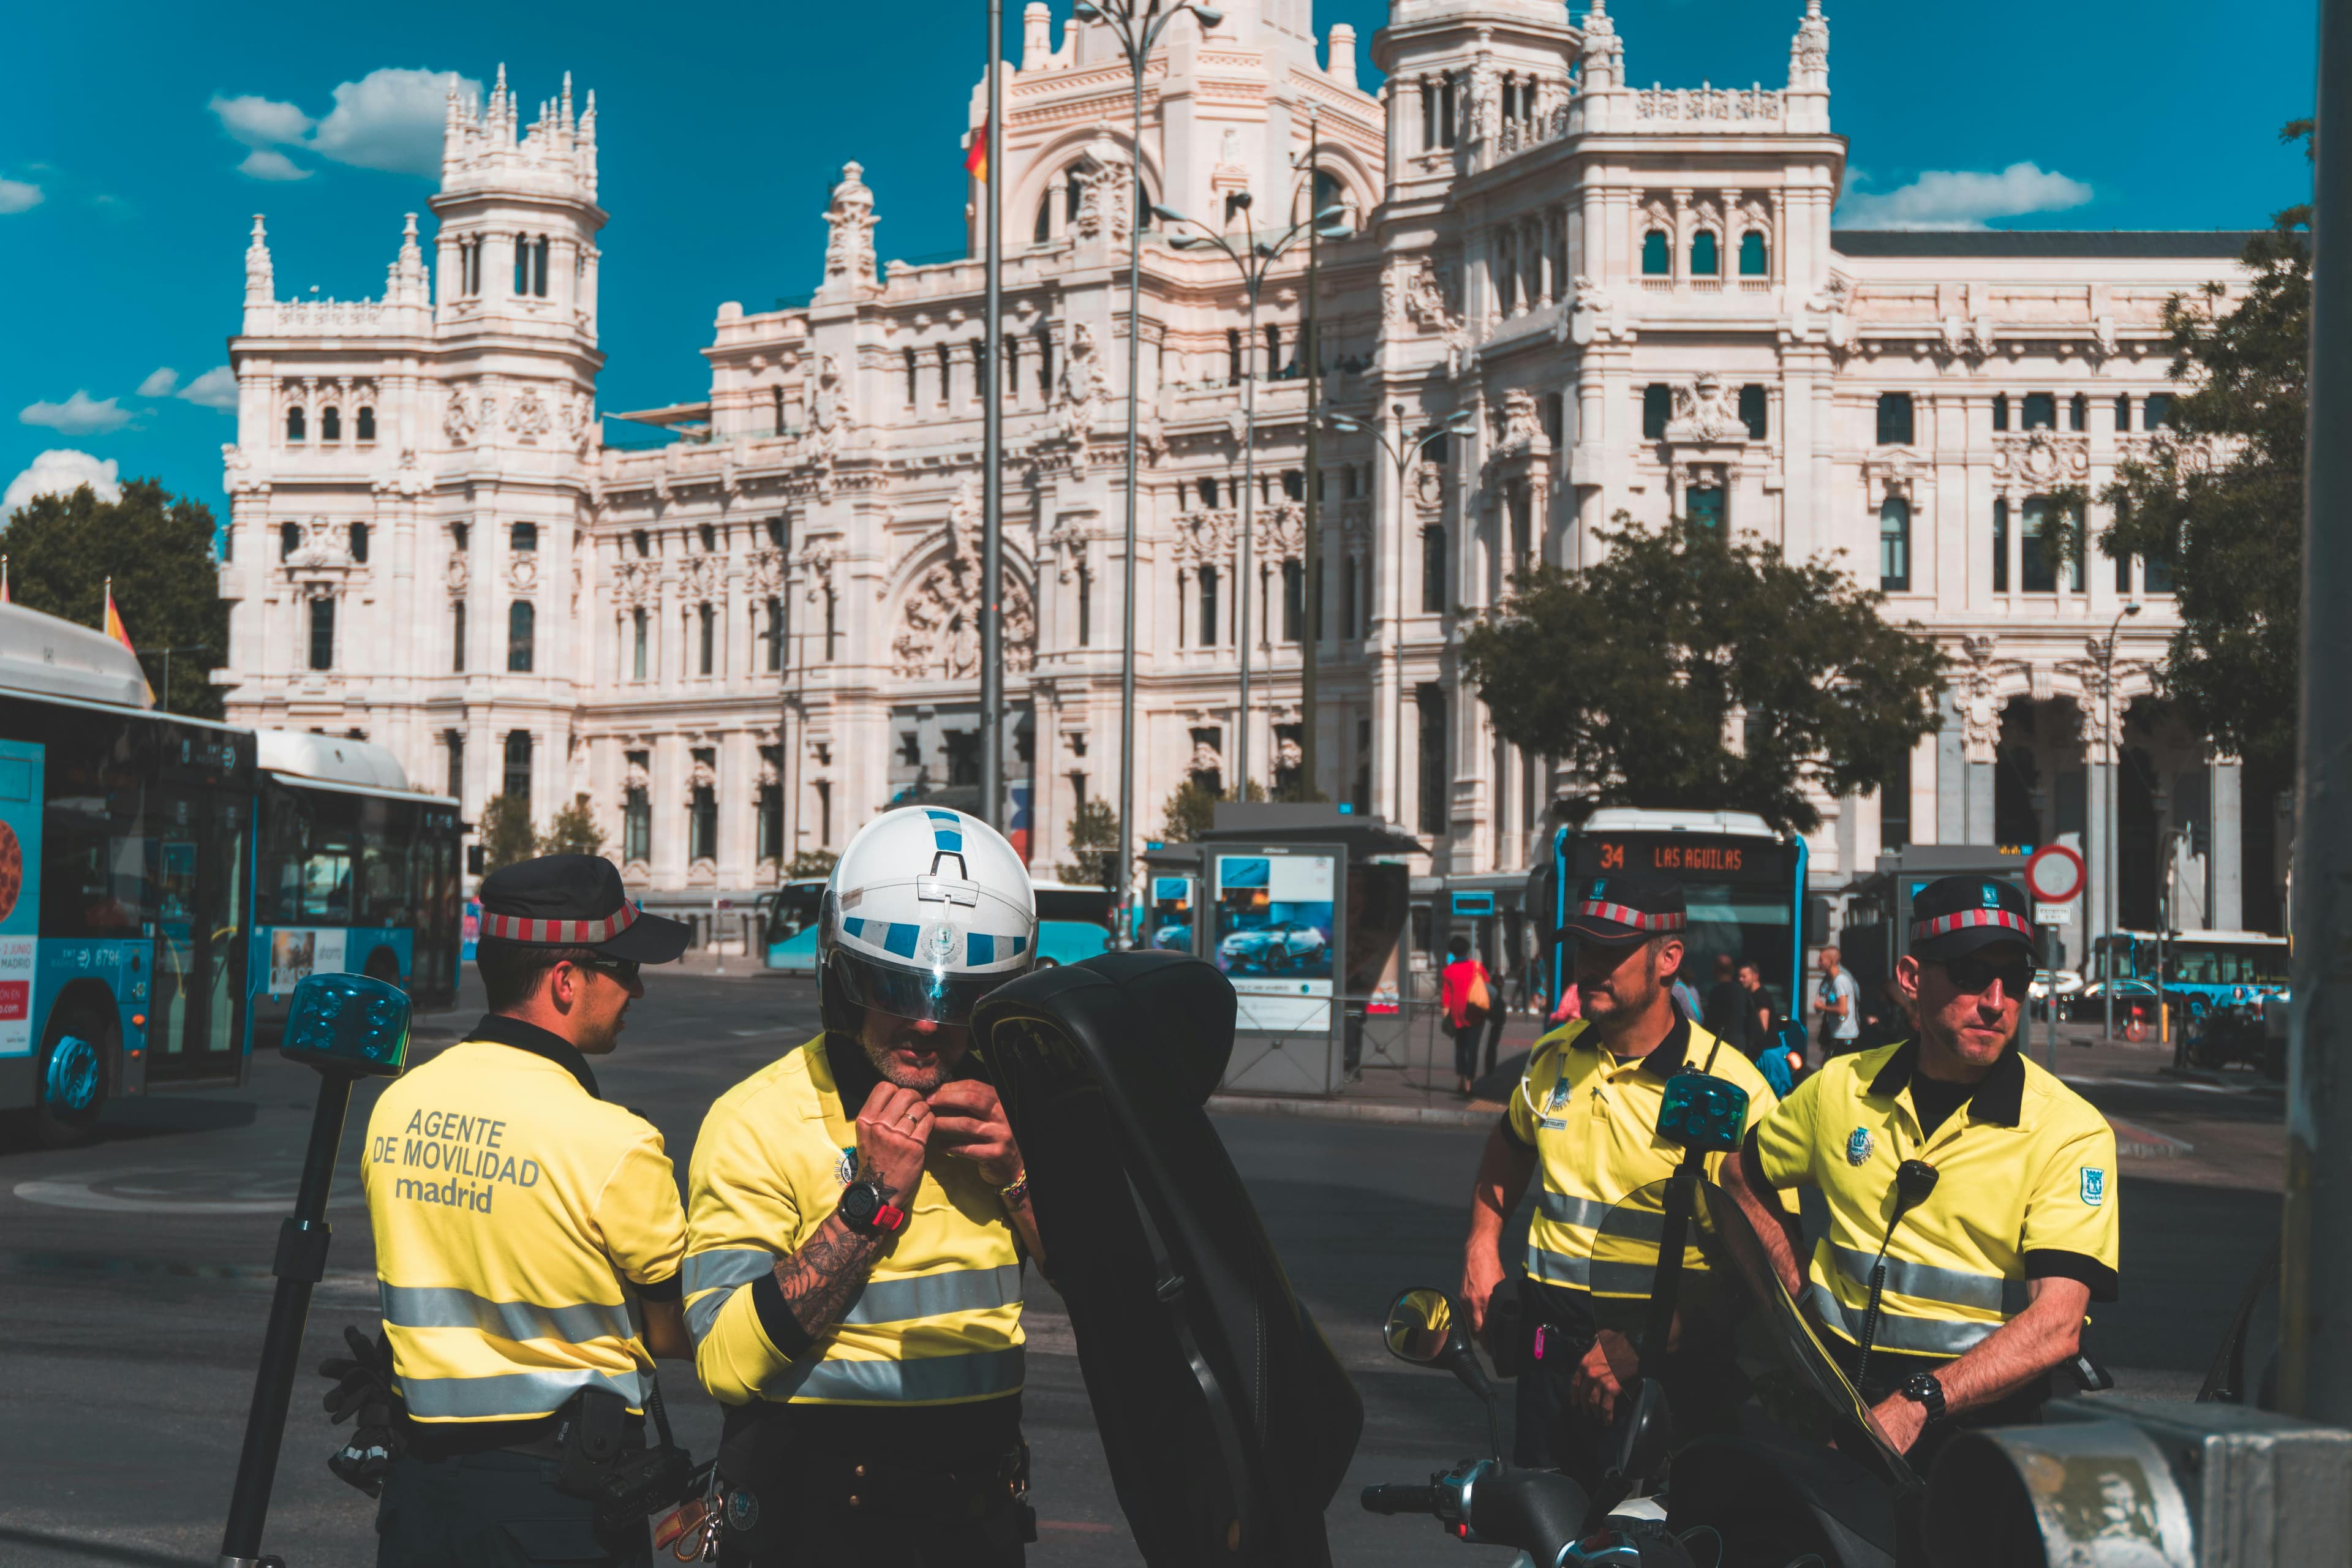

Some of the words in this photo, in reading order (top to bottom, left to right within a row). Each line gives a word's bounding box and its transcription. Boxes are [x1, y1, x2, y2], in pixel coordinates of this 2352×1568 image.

[1600, 844, 1623, 869] 34
[1655, 847, 1680, 867] LAS
[1686, 847, 1742, 870] AGUILAS
[3, 944, 7, 956] 2
[10, 943, 31, 956] JUNIO
[1, 957, 31, 970] MADRID
[0, 988, 10, 1000] ÓN
[405, 1109, 507, 1149] AGENTE
[372, 1136, 399, 1164] DE
[402, 1138, 540, 1188] MOVILIDAD
[396, 1177, 494, 1215] madrid
